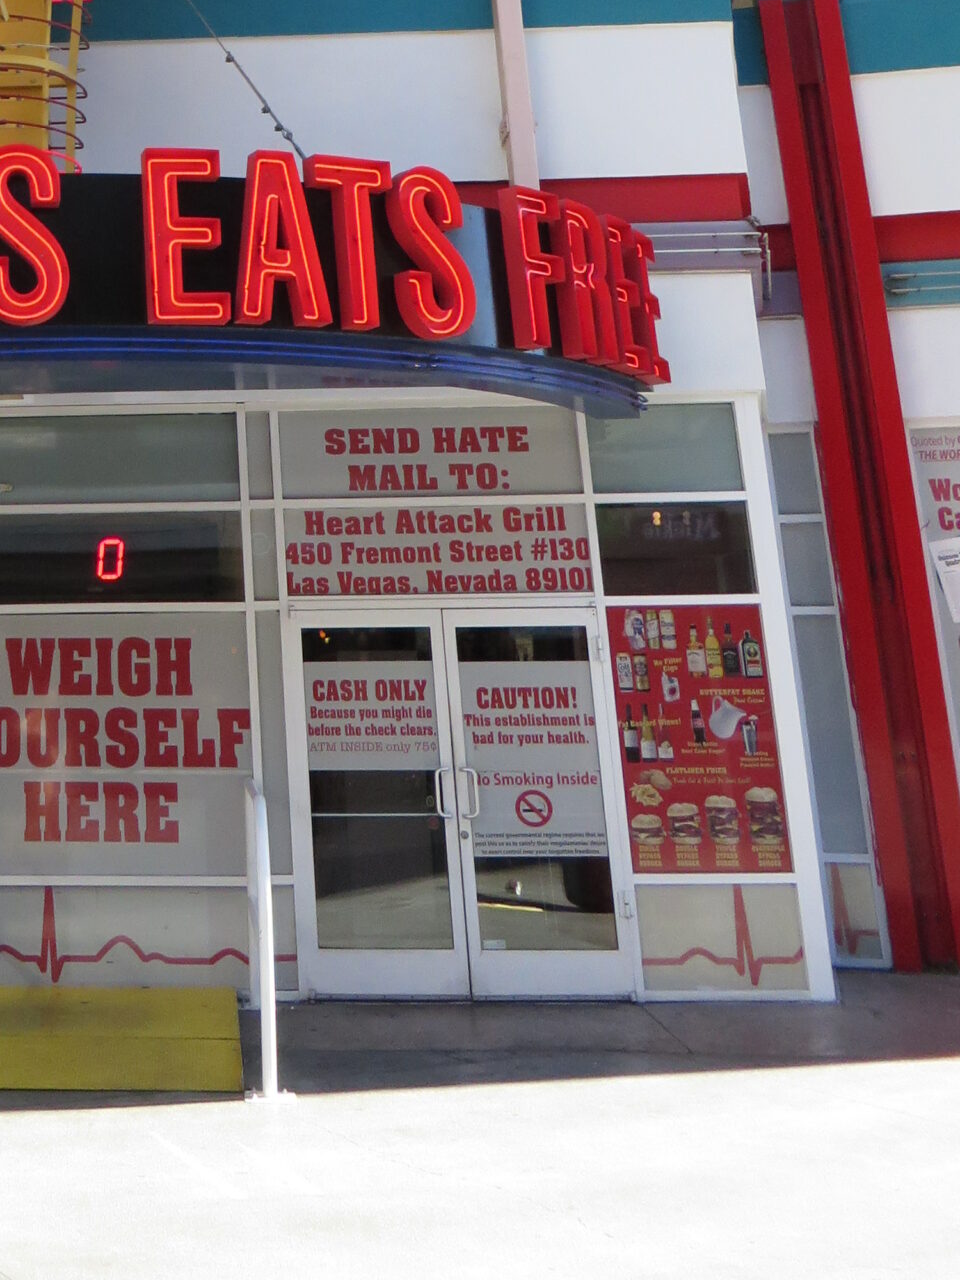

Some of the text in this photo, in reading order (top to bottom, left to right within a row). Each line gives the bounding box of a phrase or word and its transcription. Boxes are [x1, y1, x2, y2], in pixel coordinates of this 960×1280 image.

[142, 147, 476, 342] EATS
[498, 185, 671, 385] FREE
[324, 426, 529, 455] SEND HATE
[919, 450, 937, 460] THE
[348, 462, 510, 491] MAIL TO:
[304, 506, 566, 536] Heart Attack Grill
[97, 536, 124, 581] 0
[286, 537, 590, 565] 450 Fremont Street #130
[287, 572, 329, 594] Las
[337, 570, 418, 594] Vegas,
[427, 569, 518, 594] Nevada
[5, 637, 193, 696] WEIGH
[312, 679, 427, 701] CASH ONLY
[476, 686, 577, 709] CAUTION!
[310, 706, 432, 721] Because you might die
[464, 714, 596, 727] This establishment is
[308, 723, 437, 736] before the check clears.
[472, 732, 589, 746] bad for your health.
[310, 742, 336, 752] ATM
[340, 742, 383, 752] INSIDE
[386, 742, 411, 754] only
[494, 772, 554, 788] Smoking
[557, 772, 597, 785] Inside
[24, 781, 179, 843] HERE
